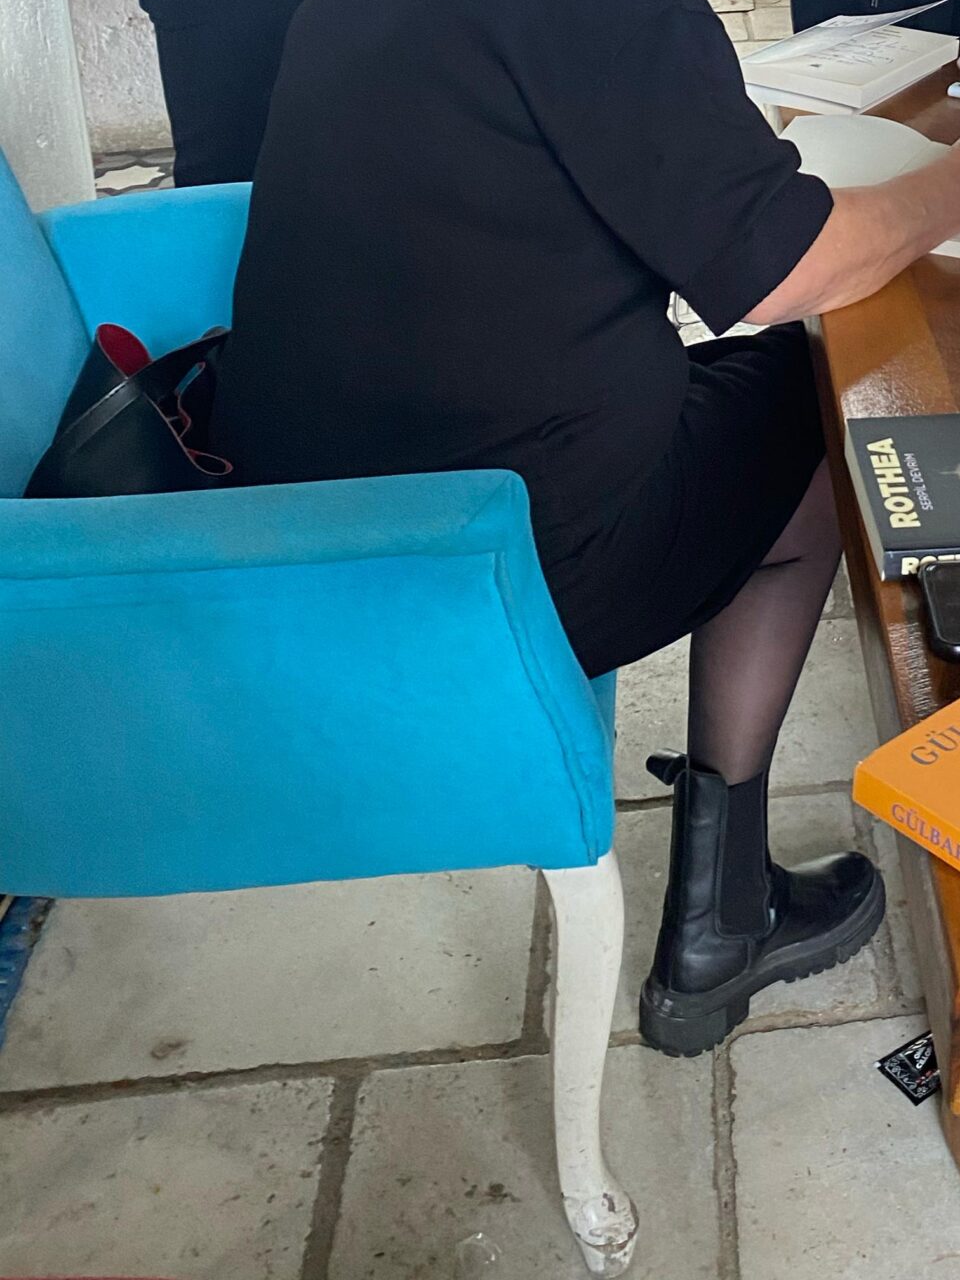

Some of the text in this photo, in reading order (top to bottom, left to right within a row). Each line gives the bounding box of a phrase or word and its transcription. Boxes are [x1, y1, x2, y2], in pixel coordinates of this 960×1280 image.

[866, 437, 921, 528] ROTHEA
[903, 452, 933, 511] SERPİL DEVRİM
